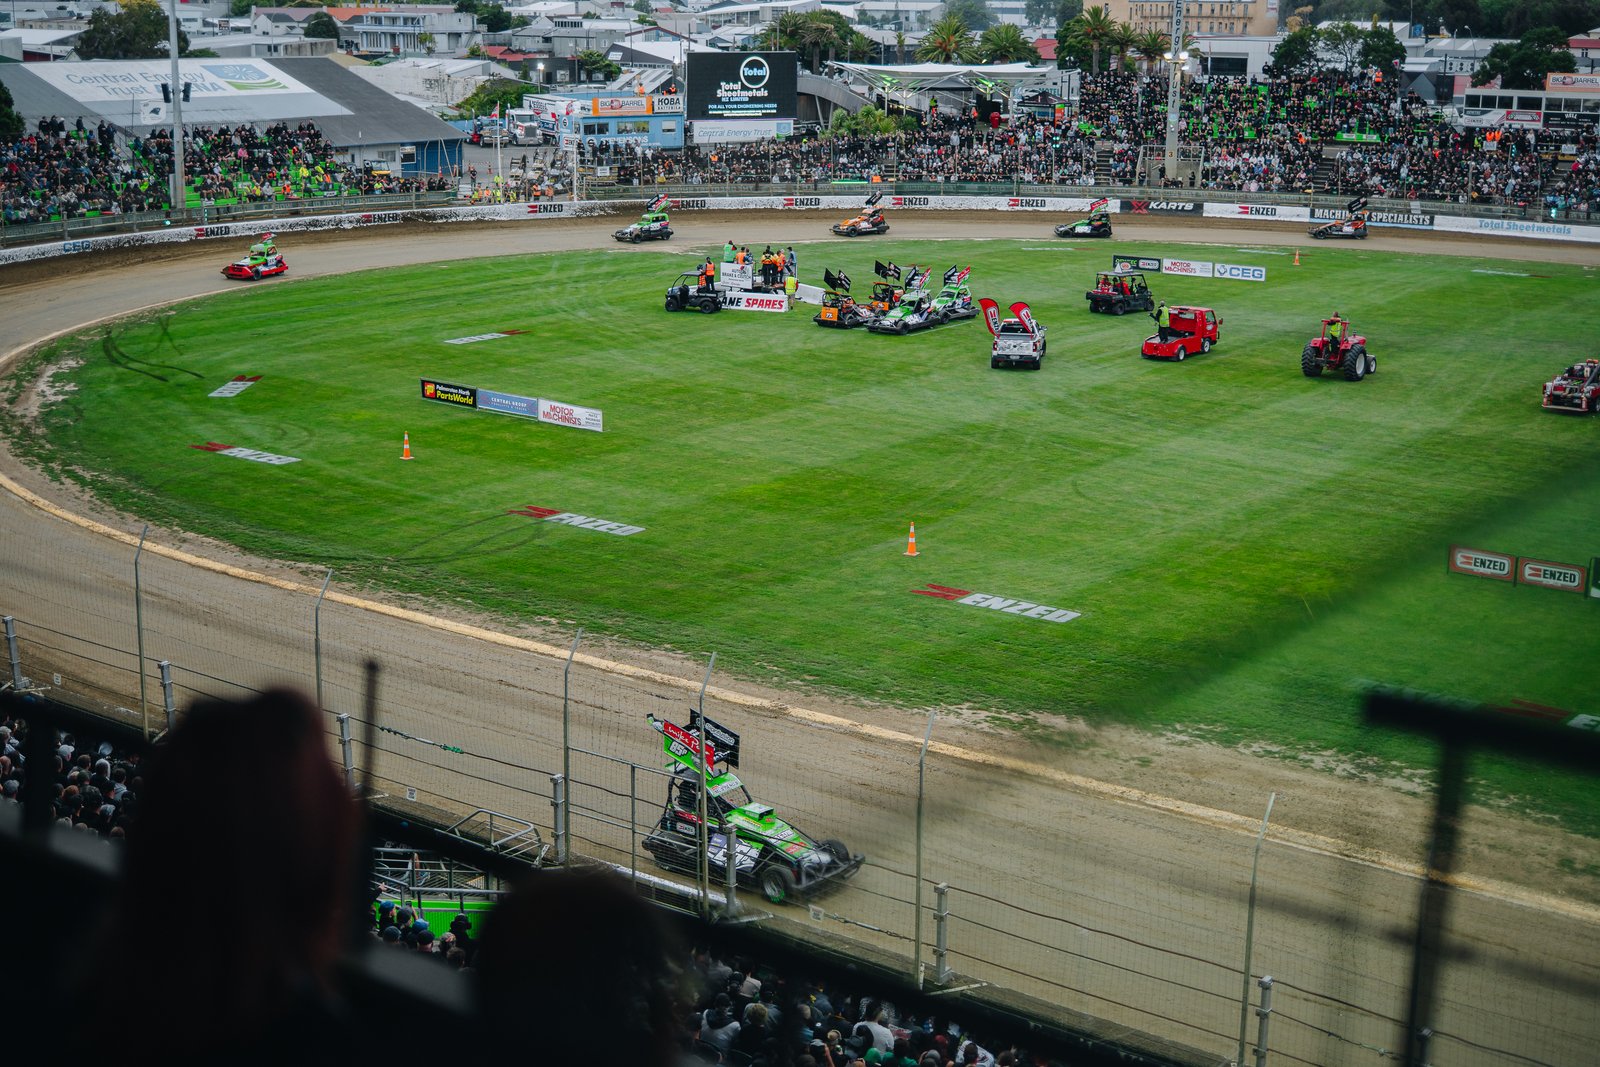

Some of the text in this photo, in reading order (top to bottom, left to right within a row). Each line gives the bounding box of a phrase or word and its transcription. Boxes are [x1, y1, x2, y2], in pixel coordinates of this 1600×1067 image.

[743, 67, 767, 76] Total
[66, 72, 206, 84] Central Enegy
[97, 85, 153, 95] Trust
[720, 82, 742, 90] Total
[1171, 62, 1181, 109] Trust
[657, 97, 681, 106] KOBA
[698, 129, 726, 138] Central
[726, 129, 753, 139] Energy
[681, 200, 706, 209] ENZED
[795, 198, 820, 207] ENZED
[904, 197, 929, 206] ENZED
[1019, 199, 1047, 208] ENZED
[1149, 202, 1194, 211] KARTS
[538, 203, 564, 214] ENZED
[1250, 206, 1277, 216] ENZED
[373, 213, 399, 224] ENZED
[1371, 211, 1431, 226] SPECIALISTS
[205, 226, 231, 237] ENZED
[1479, 220, 1572, 235] Total Sheetmetals
[1229, 267, 1264, 279] CEG
[721, 297, 785, 309] ANE SPARES
[436, 390, 474, 405] PartsWorld
[549, 404, 574, 417] MOTOR
[542, 411, 582, 426] MACHINISTS
[1473, 557, 1506, 572] ENZED
[1542, 569, 1577, 584] ENZED
[957, 592, 1082, 623] ENZED
